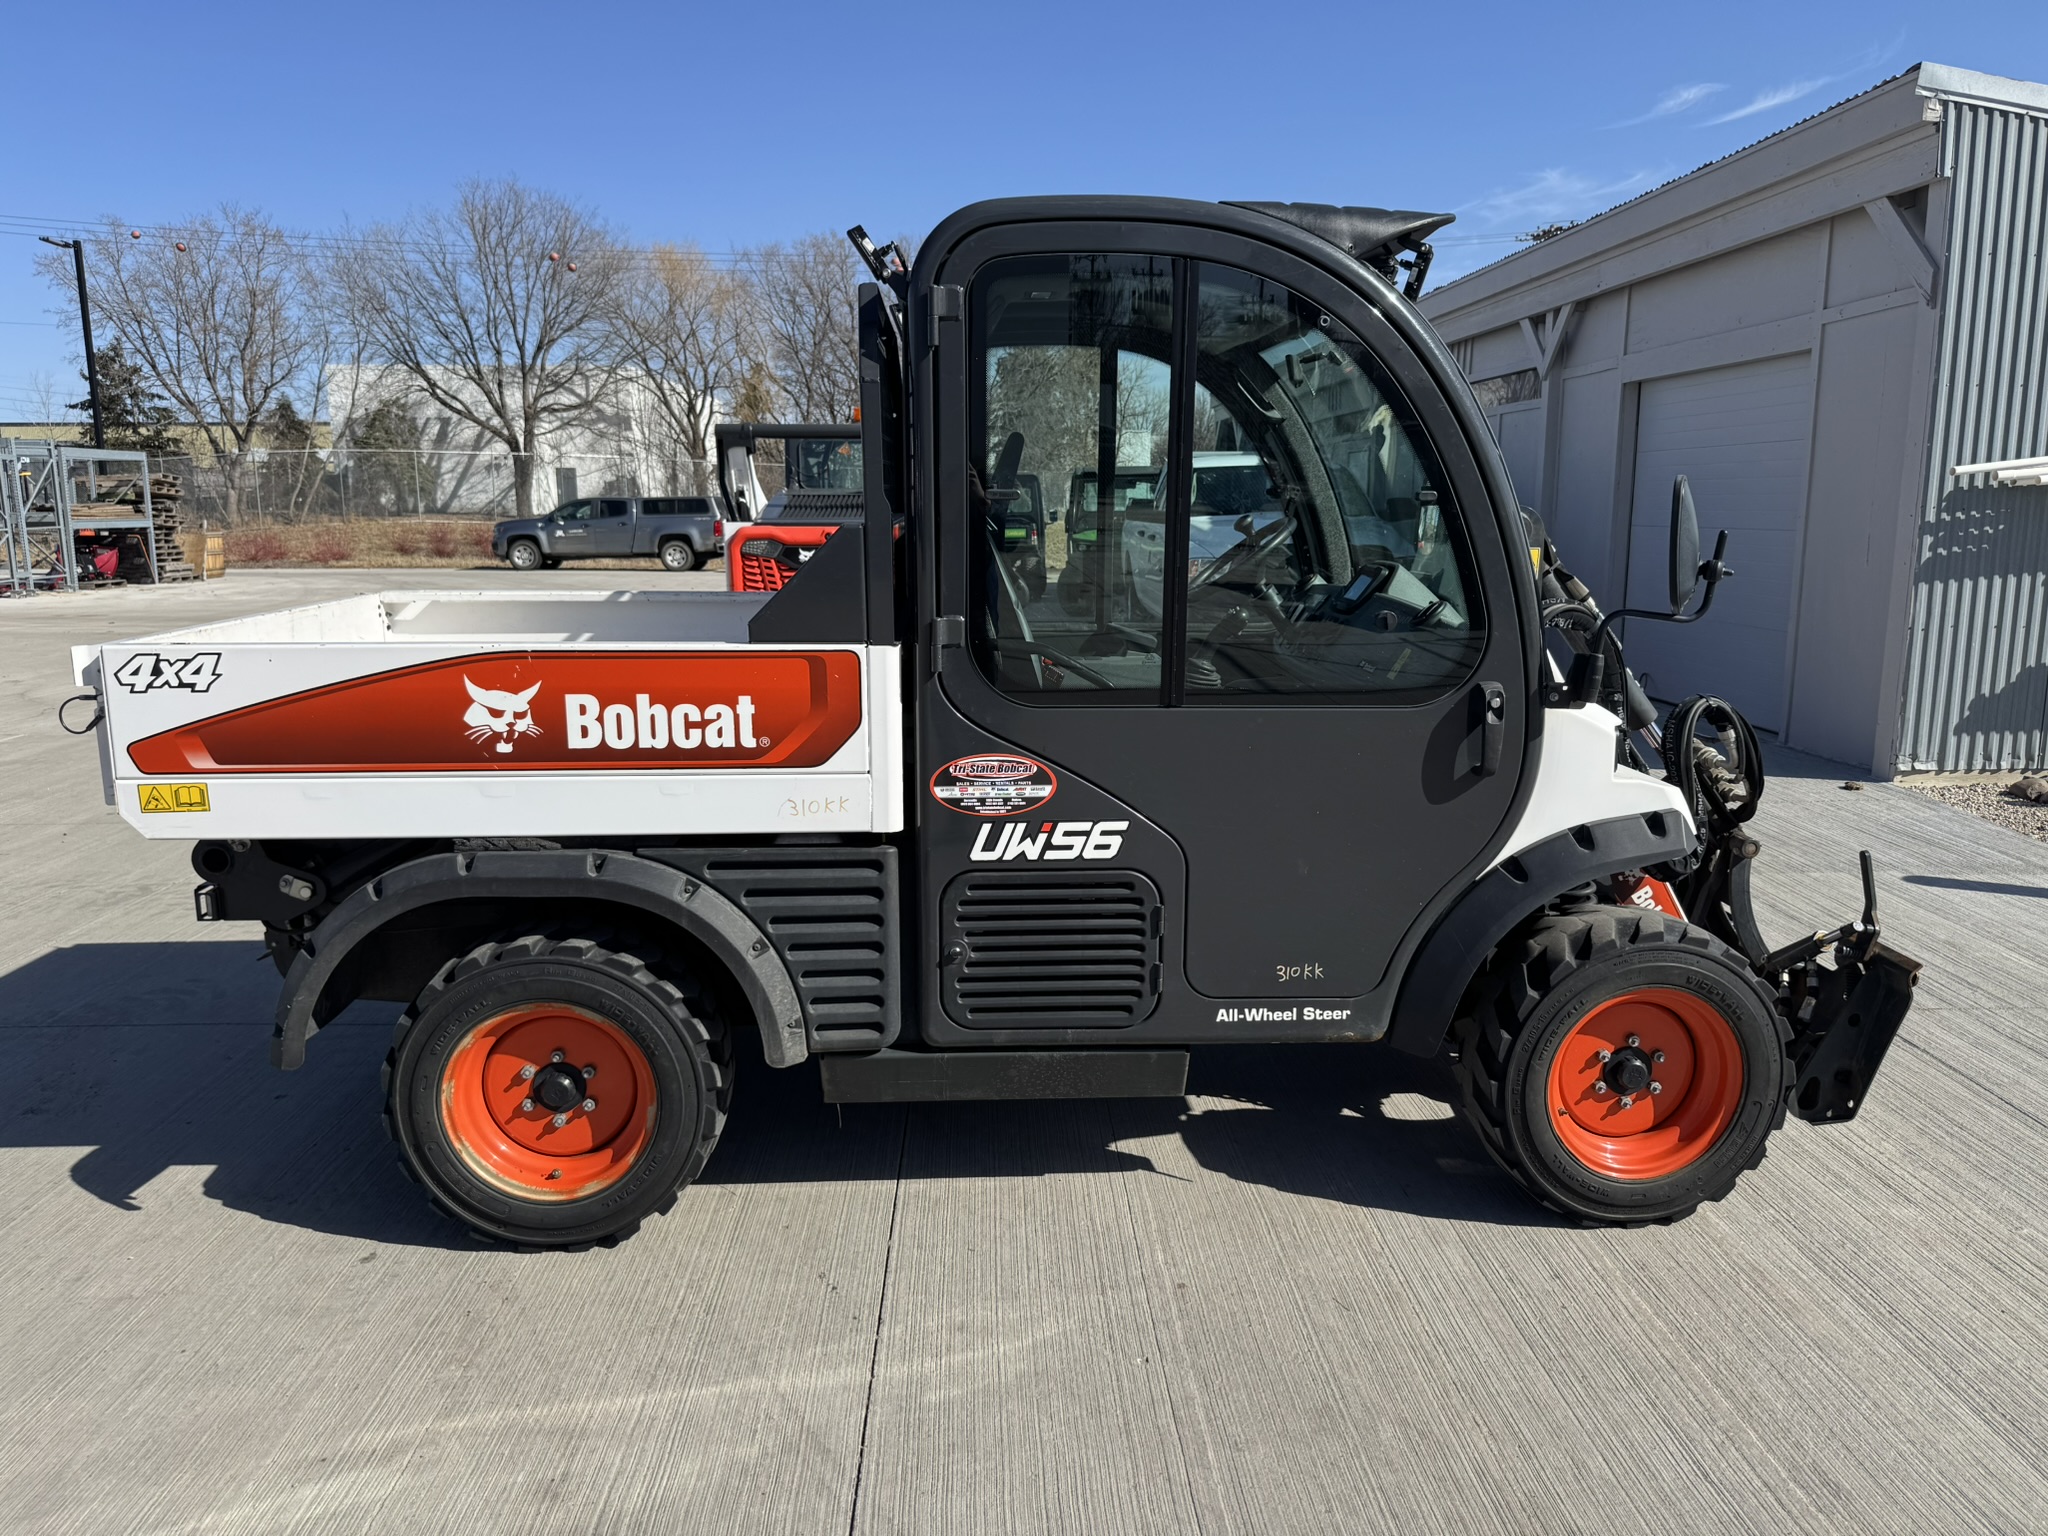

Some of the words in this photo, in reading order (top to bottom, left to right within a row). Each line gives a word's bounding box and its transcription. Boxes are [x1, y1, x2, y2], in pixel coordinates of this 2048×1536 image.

[115, 652, 223, 694] 4x4
[564, 693, 757, 750] Bobcat
[953, 763, 996, 774] Tri-State
[997, 762, 1033, 774] Bobcat
[969, 820, 1130, 861] UW56
[1216, 1007, 1297, 1022] All-Wheel
[1303, 1007, 1351, 1020] Steer
